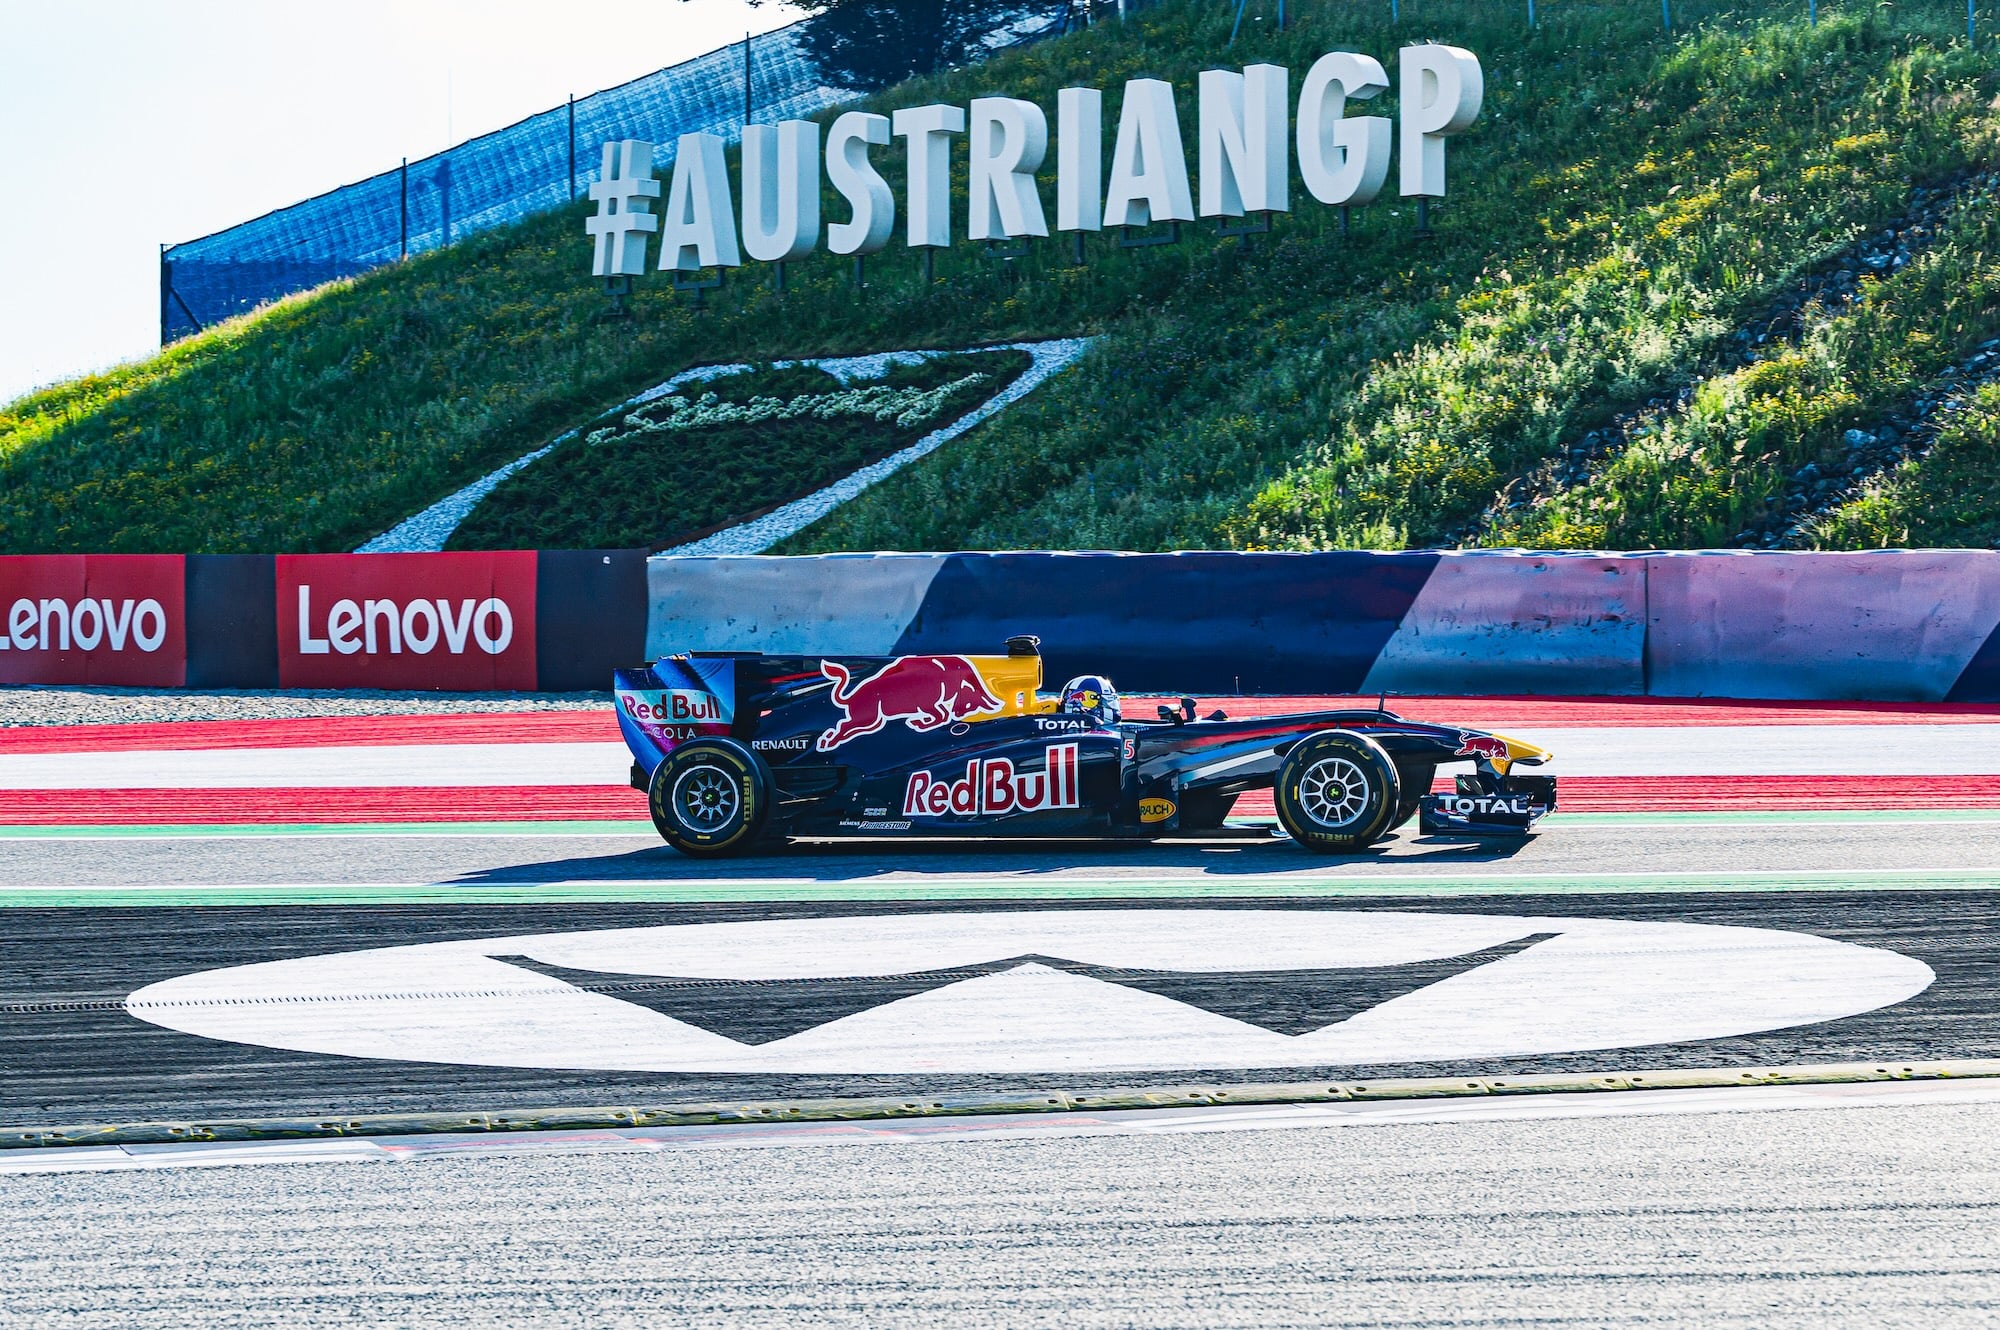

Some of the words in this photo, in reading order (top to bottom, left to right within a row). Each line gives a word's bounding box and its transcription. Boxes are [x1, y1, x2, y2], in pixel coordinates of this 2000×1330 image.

[586, 44, 1482, 276] #AUSTRIANGP
[0, 598, 166, 651] enovo
[299, 584, 513, 655] Lenovo
[621, 694, 668, 720] Red
[671, 694, 721, 719] Bull
[652, 727, 697, 739] COLA
[1034, 718, 1092, 730] TOTAL
[751, 739, 809, 750] RENAULT
[1123, 739, 1135, 760] 5
[902, 758, 981, 816] Red
[982, 743, 1080, 815] Bull
[1139, 804, 1169, 815] RAUCH
[1438, 795, 1529, 813] TOTAL
